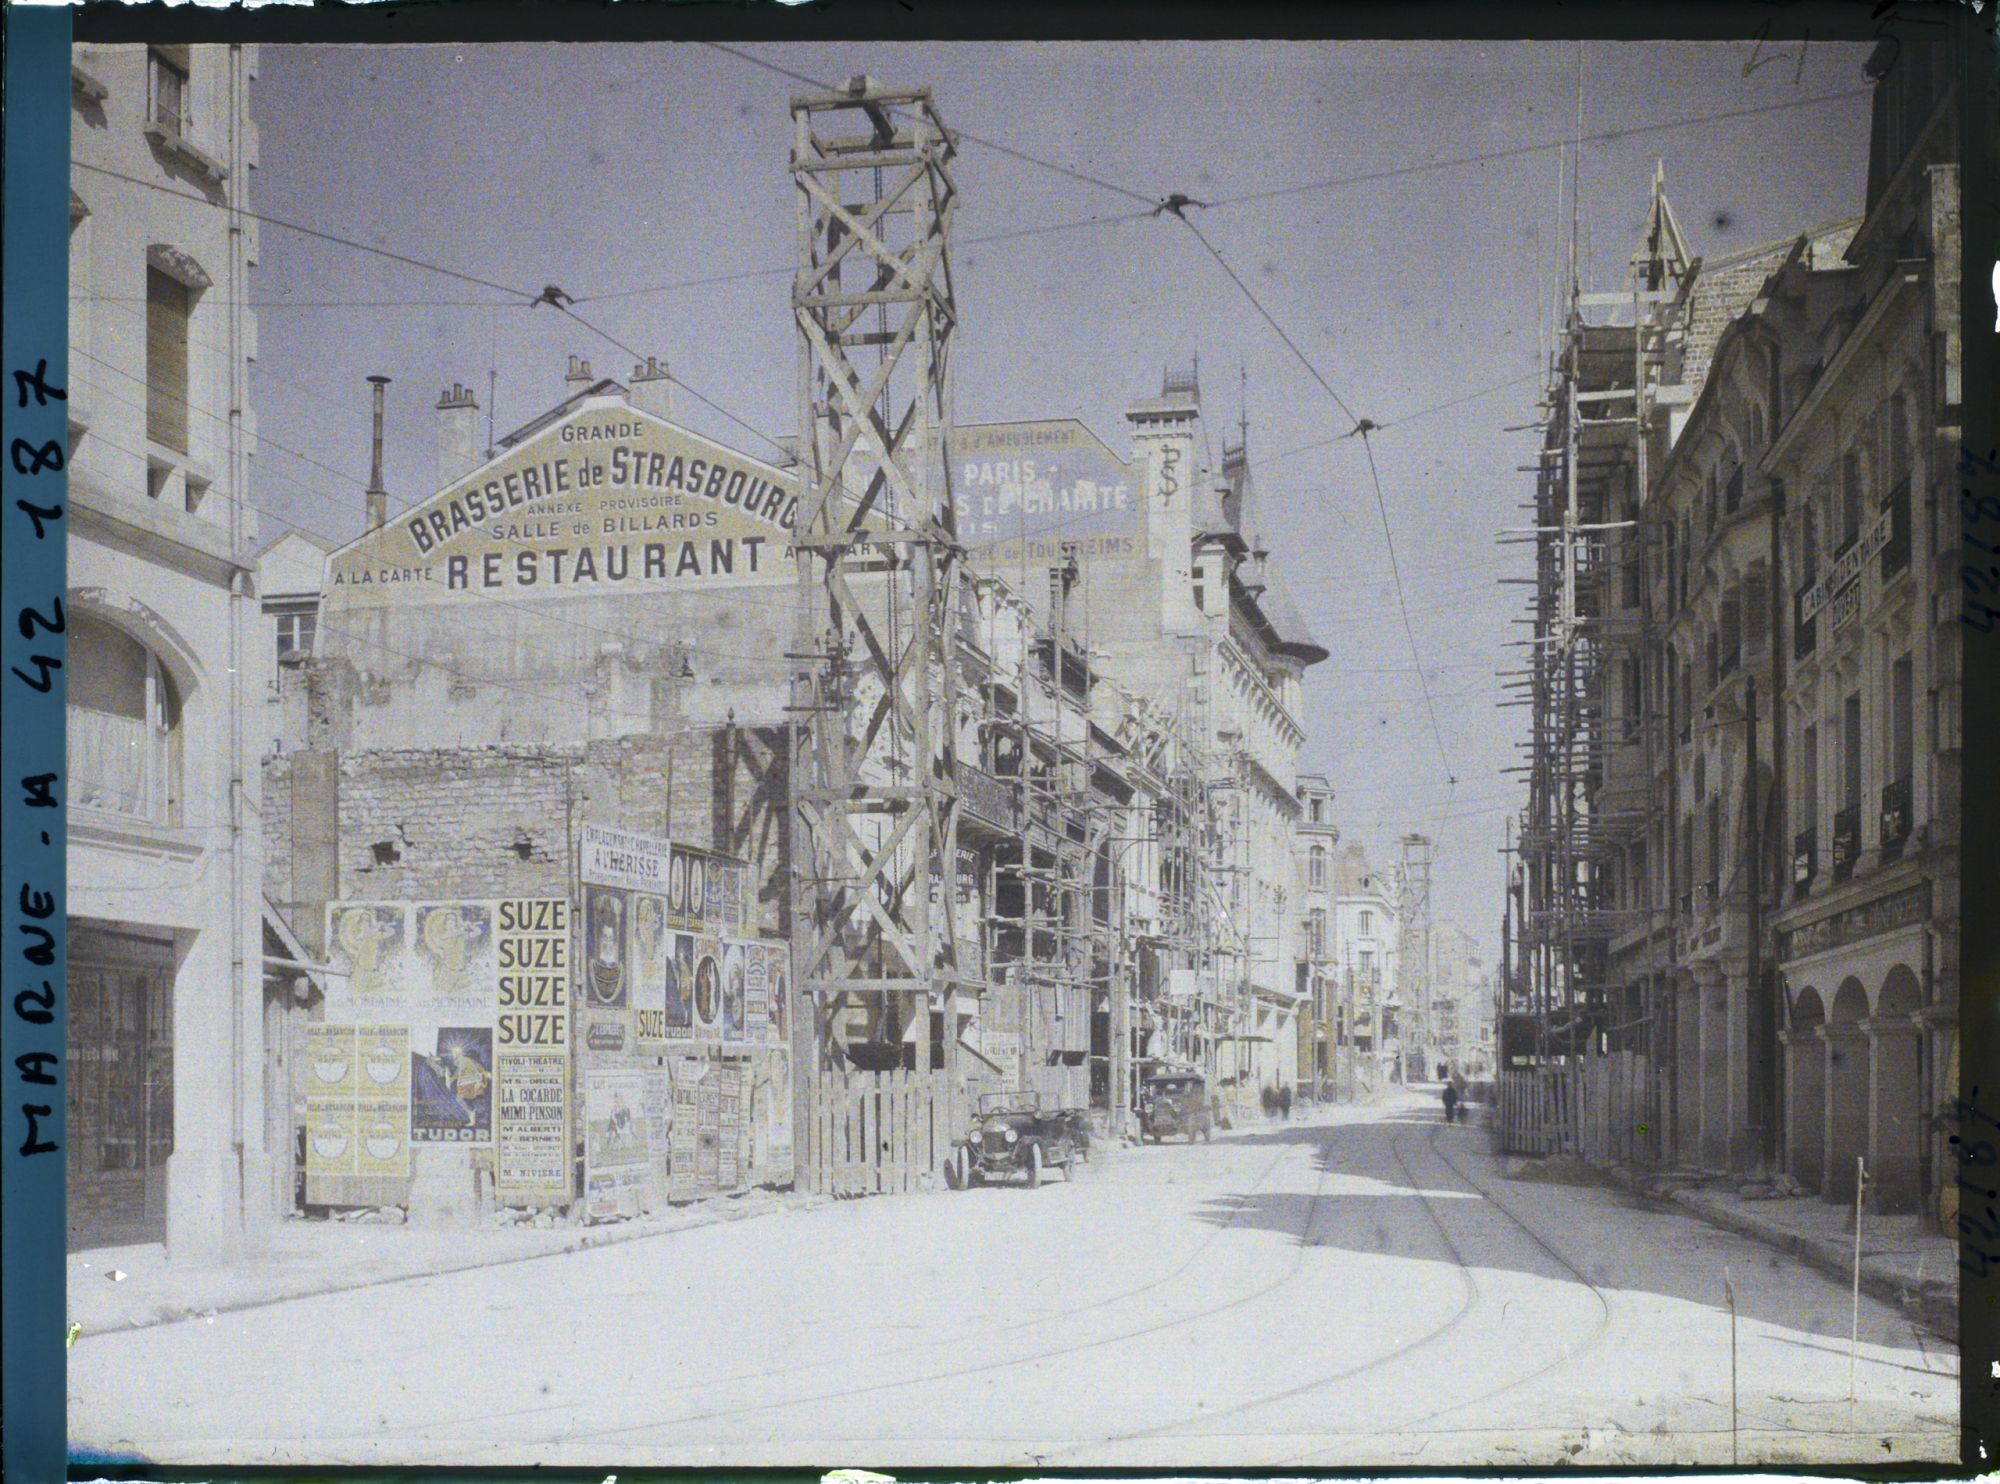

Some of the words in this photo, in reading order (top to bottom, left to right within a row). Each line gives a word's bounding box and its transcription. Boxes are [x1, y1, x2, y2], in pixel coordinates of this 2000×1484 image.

[561, 422, 644, 443] GRANDE
[12, 359, 67, 539] 187
[964, 459, 1036, 486] PARIS
[408, 457, 570, 553] BRASSERIE
[578, 458, 604, 488] de
[611, 446, 800, 530] STRASBOURG
[527, 503, 583, 516] ANNEXE
[600, 495, 682, 511] PROVISOIRE
[492, 521, 559, 541] SALLE
[572, 520, 590, 536] de
[602, 511, 719, 534] BILLARDS
[335, 571, 345, 585] A
[351, 569, 373, 584] LA
[379, 566, 433, 583] CARTE
[447, 536, 766, 591] RESTAURANT
[13, 597, 66, 693] 42
[21, 773, 58, 808] A
[499, 901, 566, 931] SUZE
[499, 938, 566, 968] SUZE
[499, 976, 566, 1006] SUZE
[14, 883, 59, 1157] MARNE
[499, 1014, 566, 1045] SUZE
[639, 1010, 663, 1038] SUZE
[502, 1089, 515, 1103] LA
[521, 1088, 563, 1103] COCARDE
[413, 1128, 490, 1141] TUDOR
